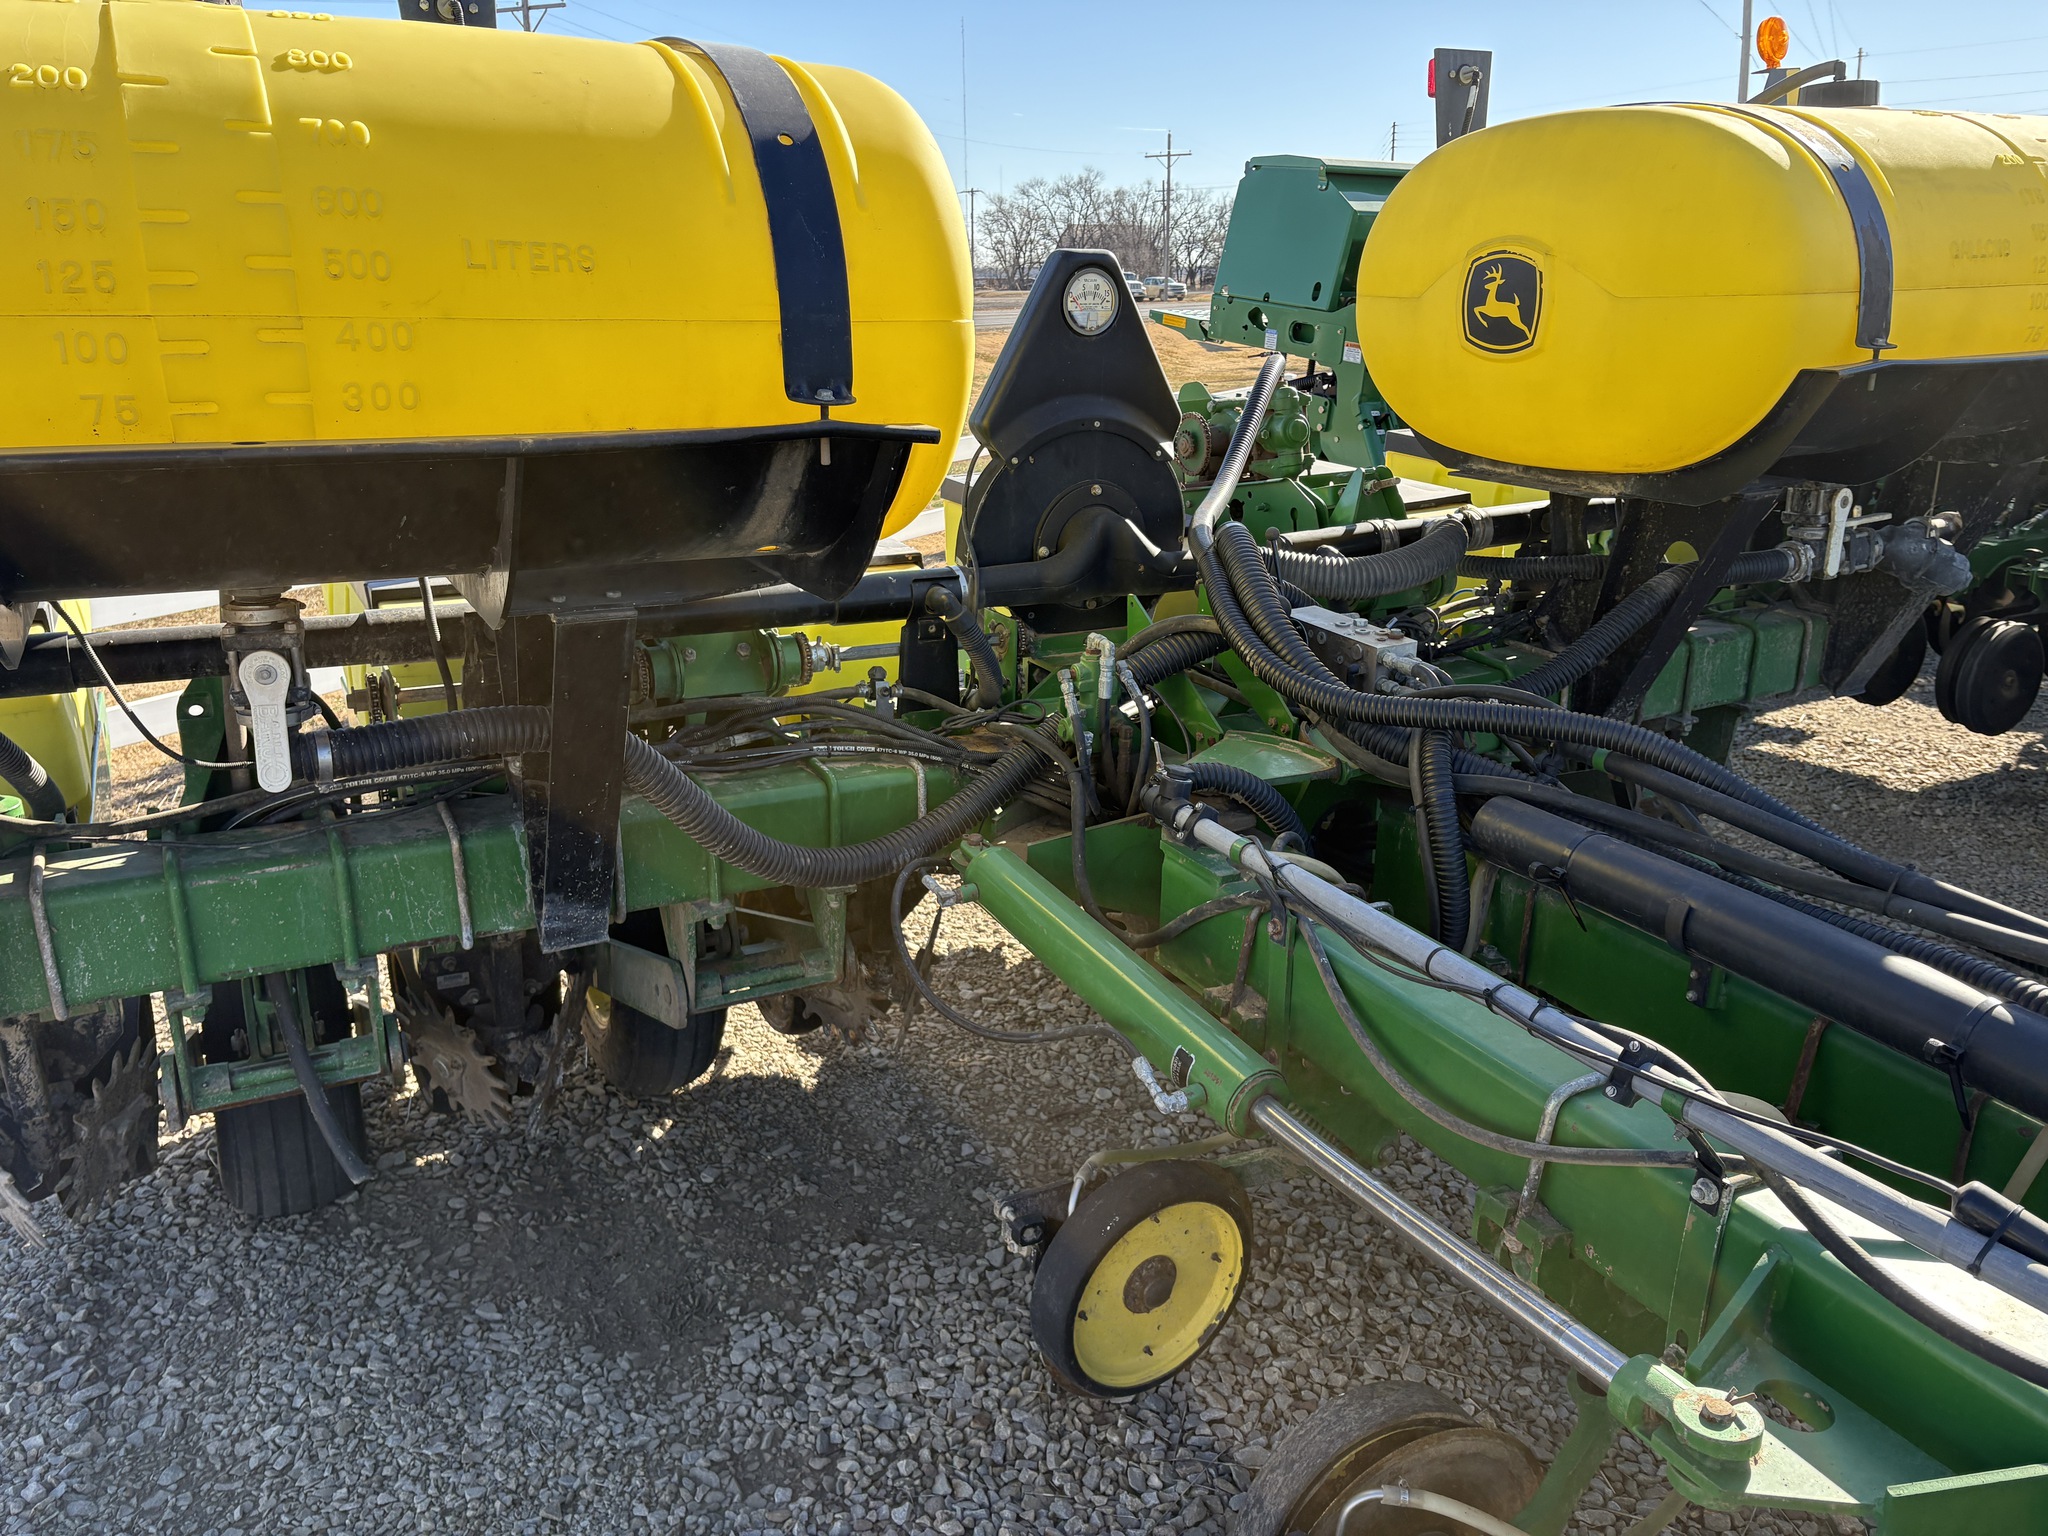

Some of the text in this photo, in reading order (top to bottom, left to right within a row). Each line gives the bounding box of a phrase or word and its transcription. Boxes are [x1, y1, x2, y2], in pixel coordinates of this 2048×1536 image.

[285, 48, 353, 70] 800
[9, 62, 88, 90] 200
[15, 129, 97, 160] 175
[299, 117, 370, 147] 700
[25, 196, 106, 232] 150
[312, 186, 383, 218] 600
[322, 248, 392, 282] 500
[462, 238, 596, 273] LITERS
[36, 259, 116, 294] 125
[53, 331, 128, 365] 100
[336, 321, 414, 352] 400
[79, 394, 141, 426] 75
[342, 382, 420, 411] 300
[344, 778, 372, 789] TOUGH
[374, 775, 397, 784] COVER
[438, 768, 450, 776] 35.0
